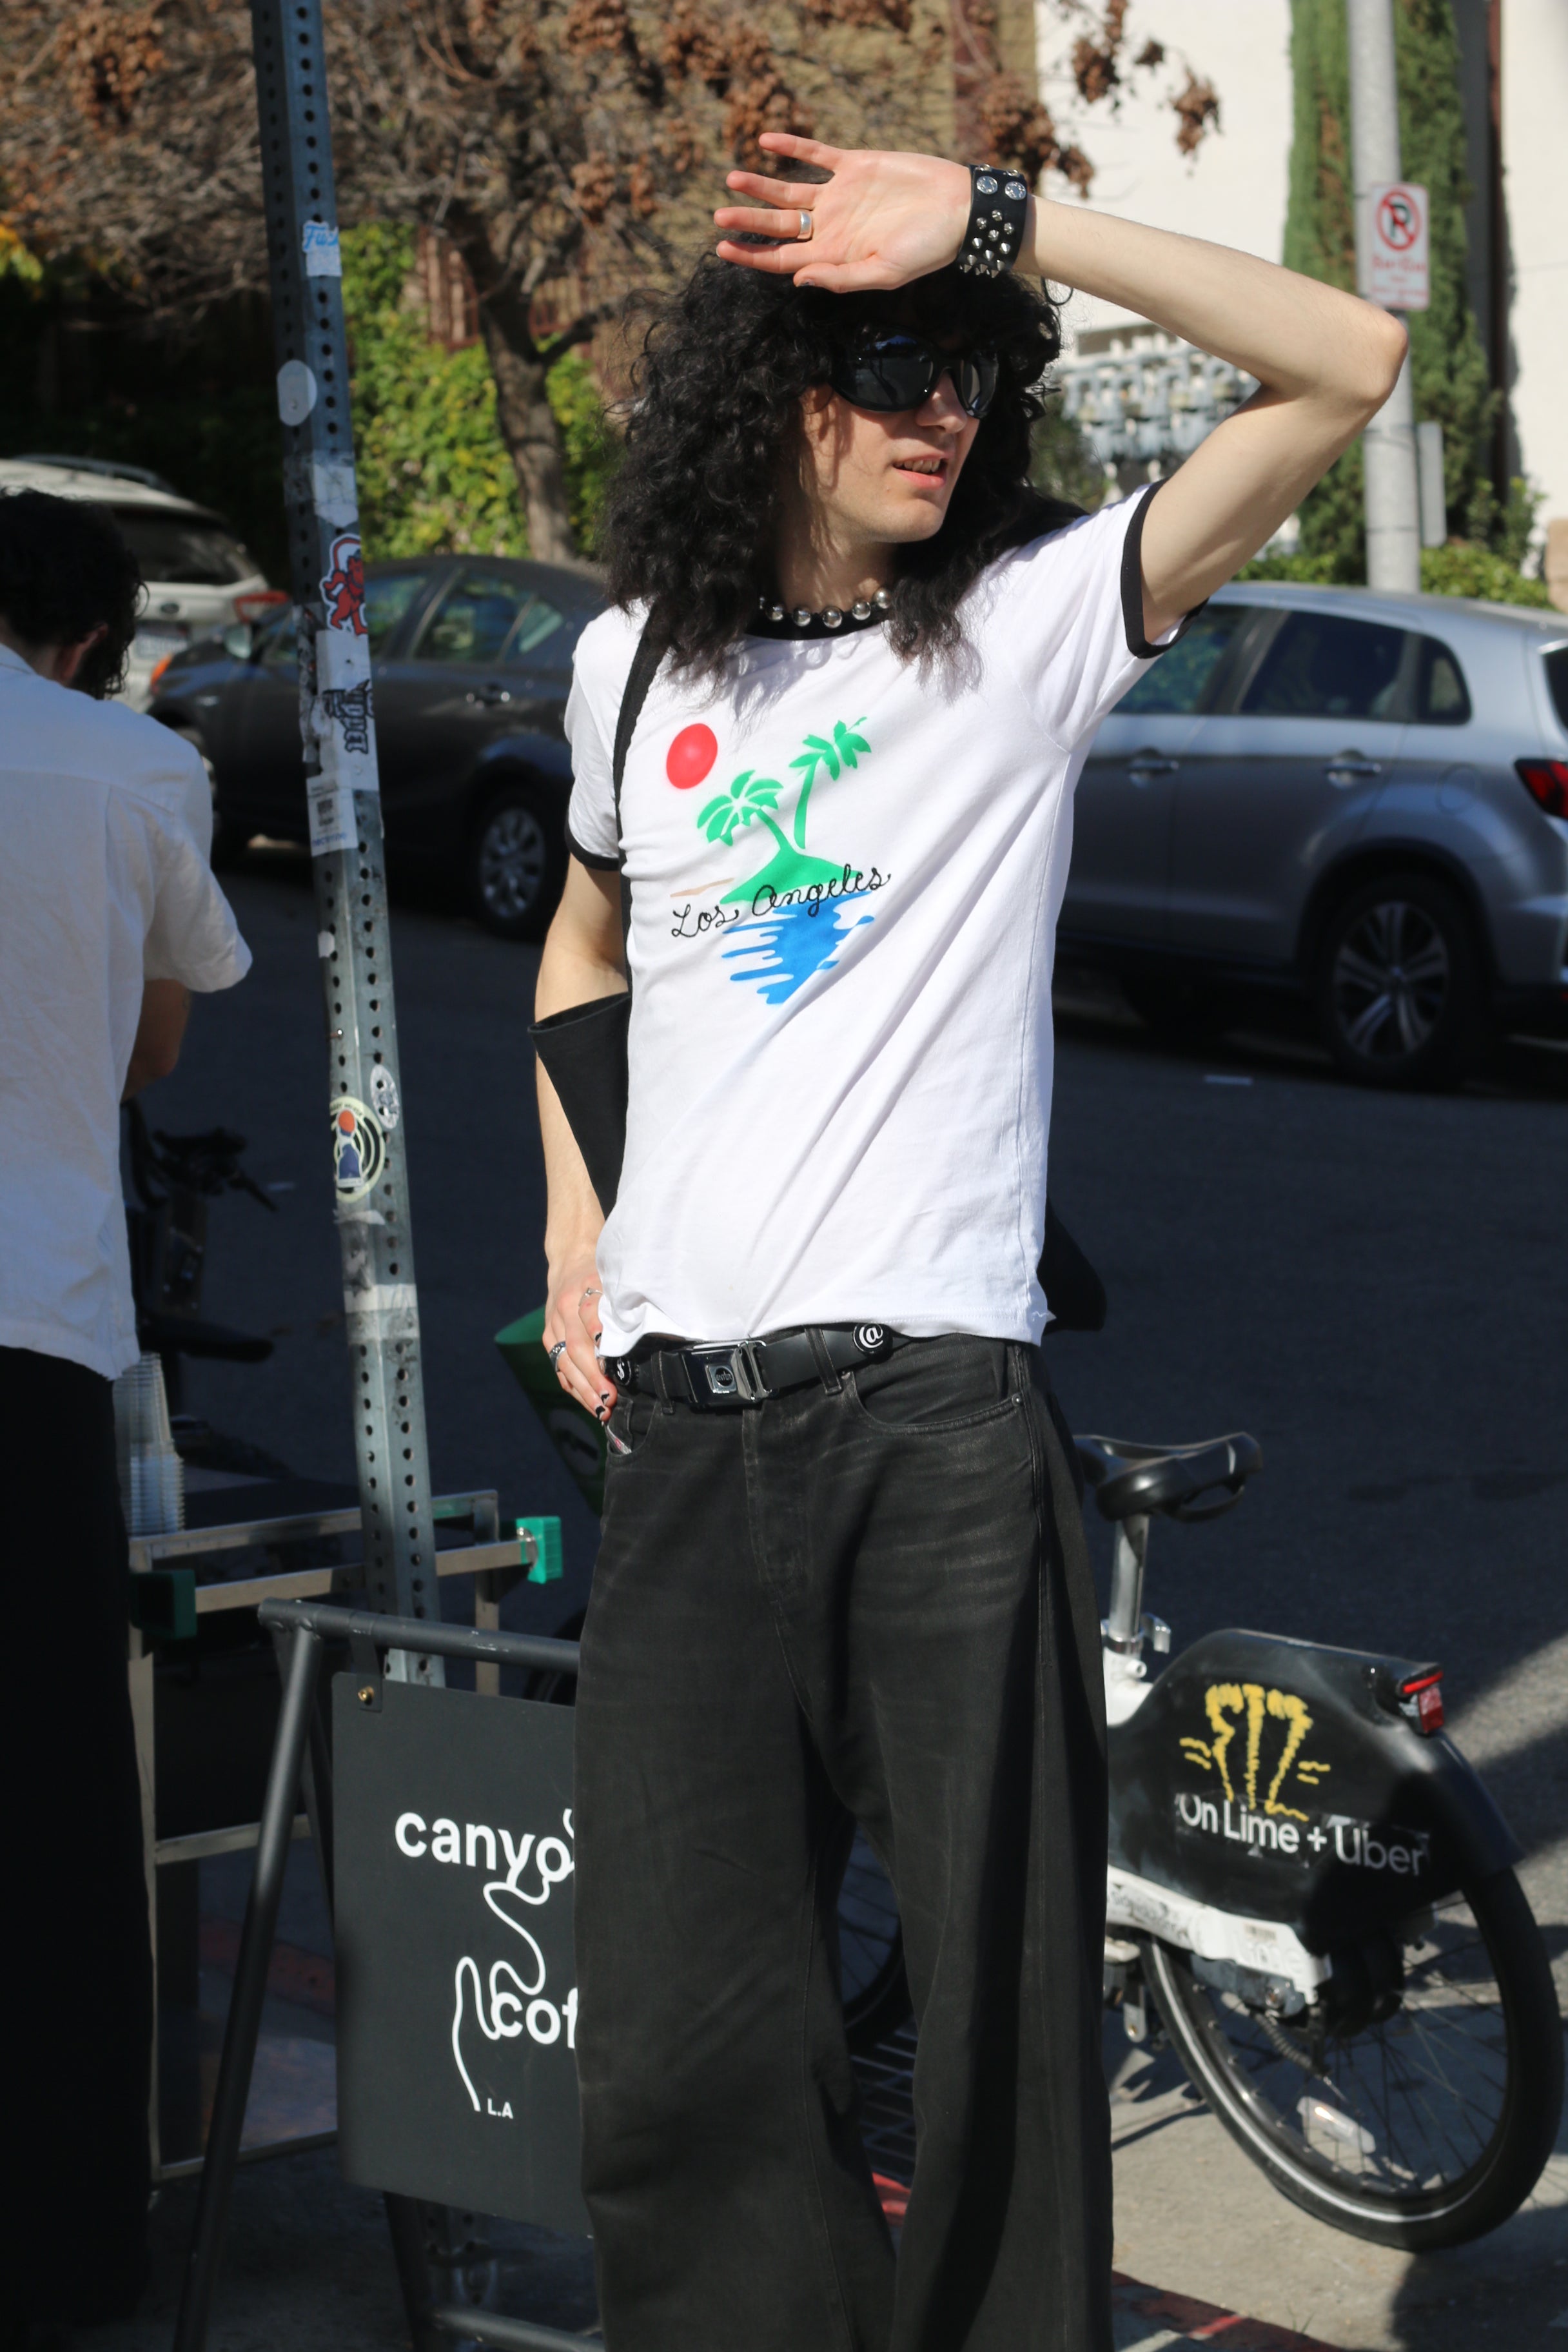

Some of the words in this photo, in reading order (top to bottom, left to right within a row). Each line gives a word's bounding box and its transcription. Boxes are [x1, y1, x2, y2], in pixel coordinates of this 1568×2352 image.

[671, 903, 740, 937] Los
[751, 863, 892, 917] Angeles
[1224, 1799, 1300, 1854] Lime
[1307, 1826, 1328, 1852] +
[1335, 1824, 1424, 1876] Uber
